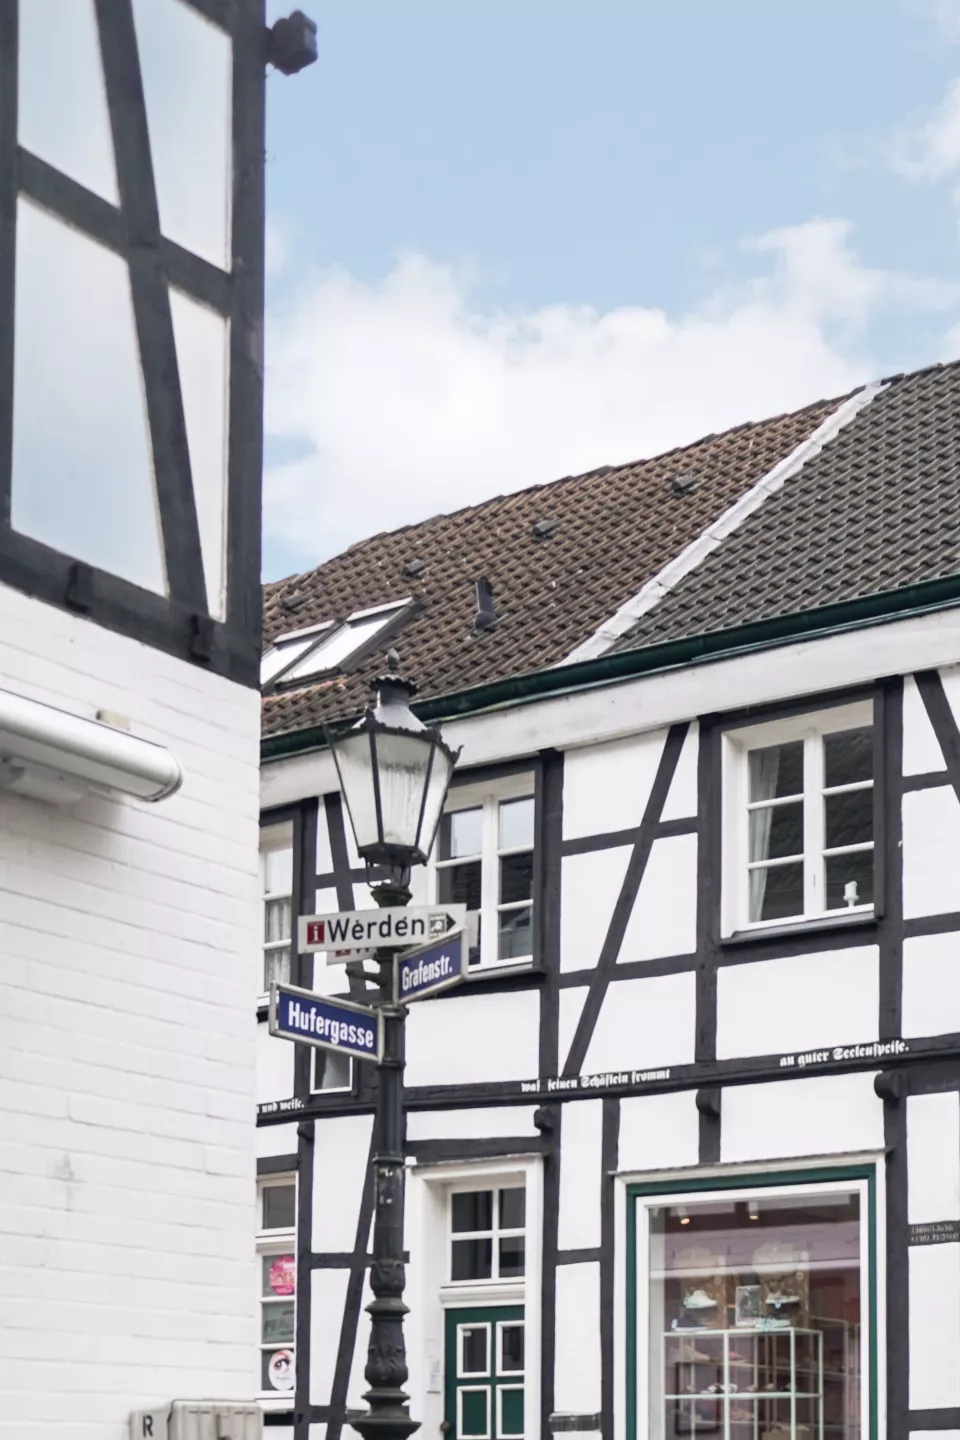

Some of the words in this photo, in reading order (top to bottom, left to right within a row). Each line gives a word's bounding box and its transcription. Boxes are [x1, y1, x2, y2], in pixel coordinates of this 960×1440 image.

[327, 913, 425, 943] Werden
[401, 955, 453, 992] Grafenstr.
[288, 1000, 374, 1048] Hufergasse
